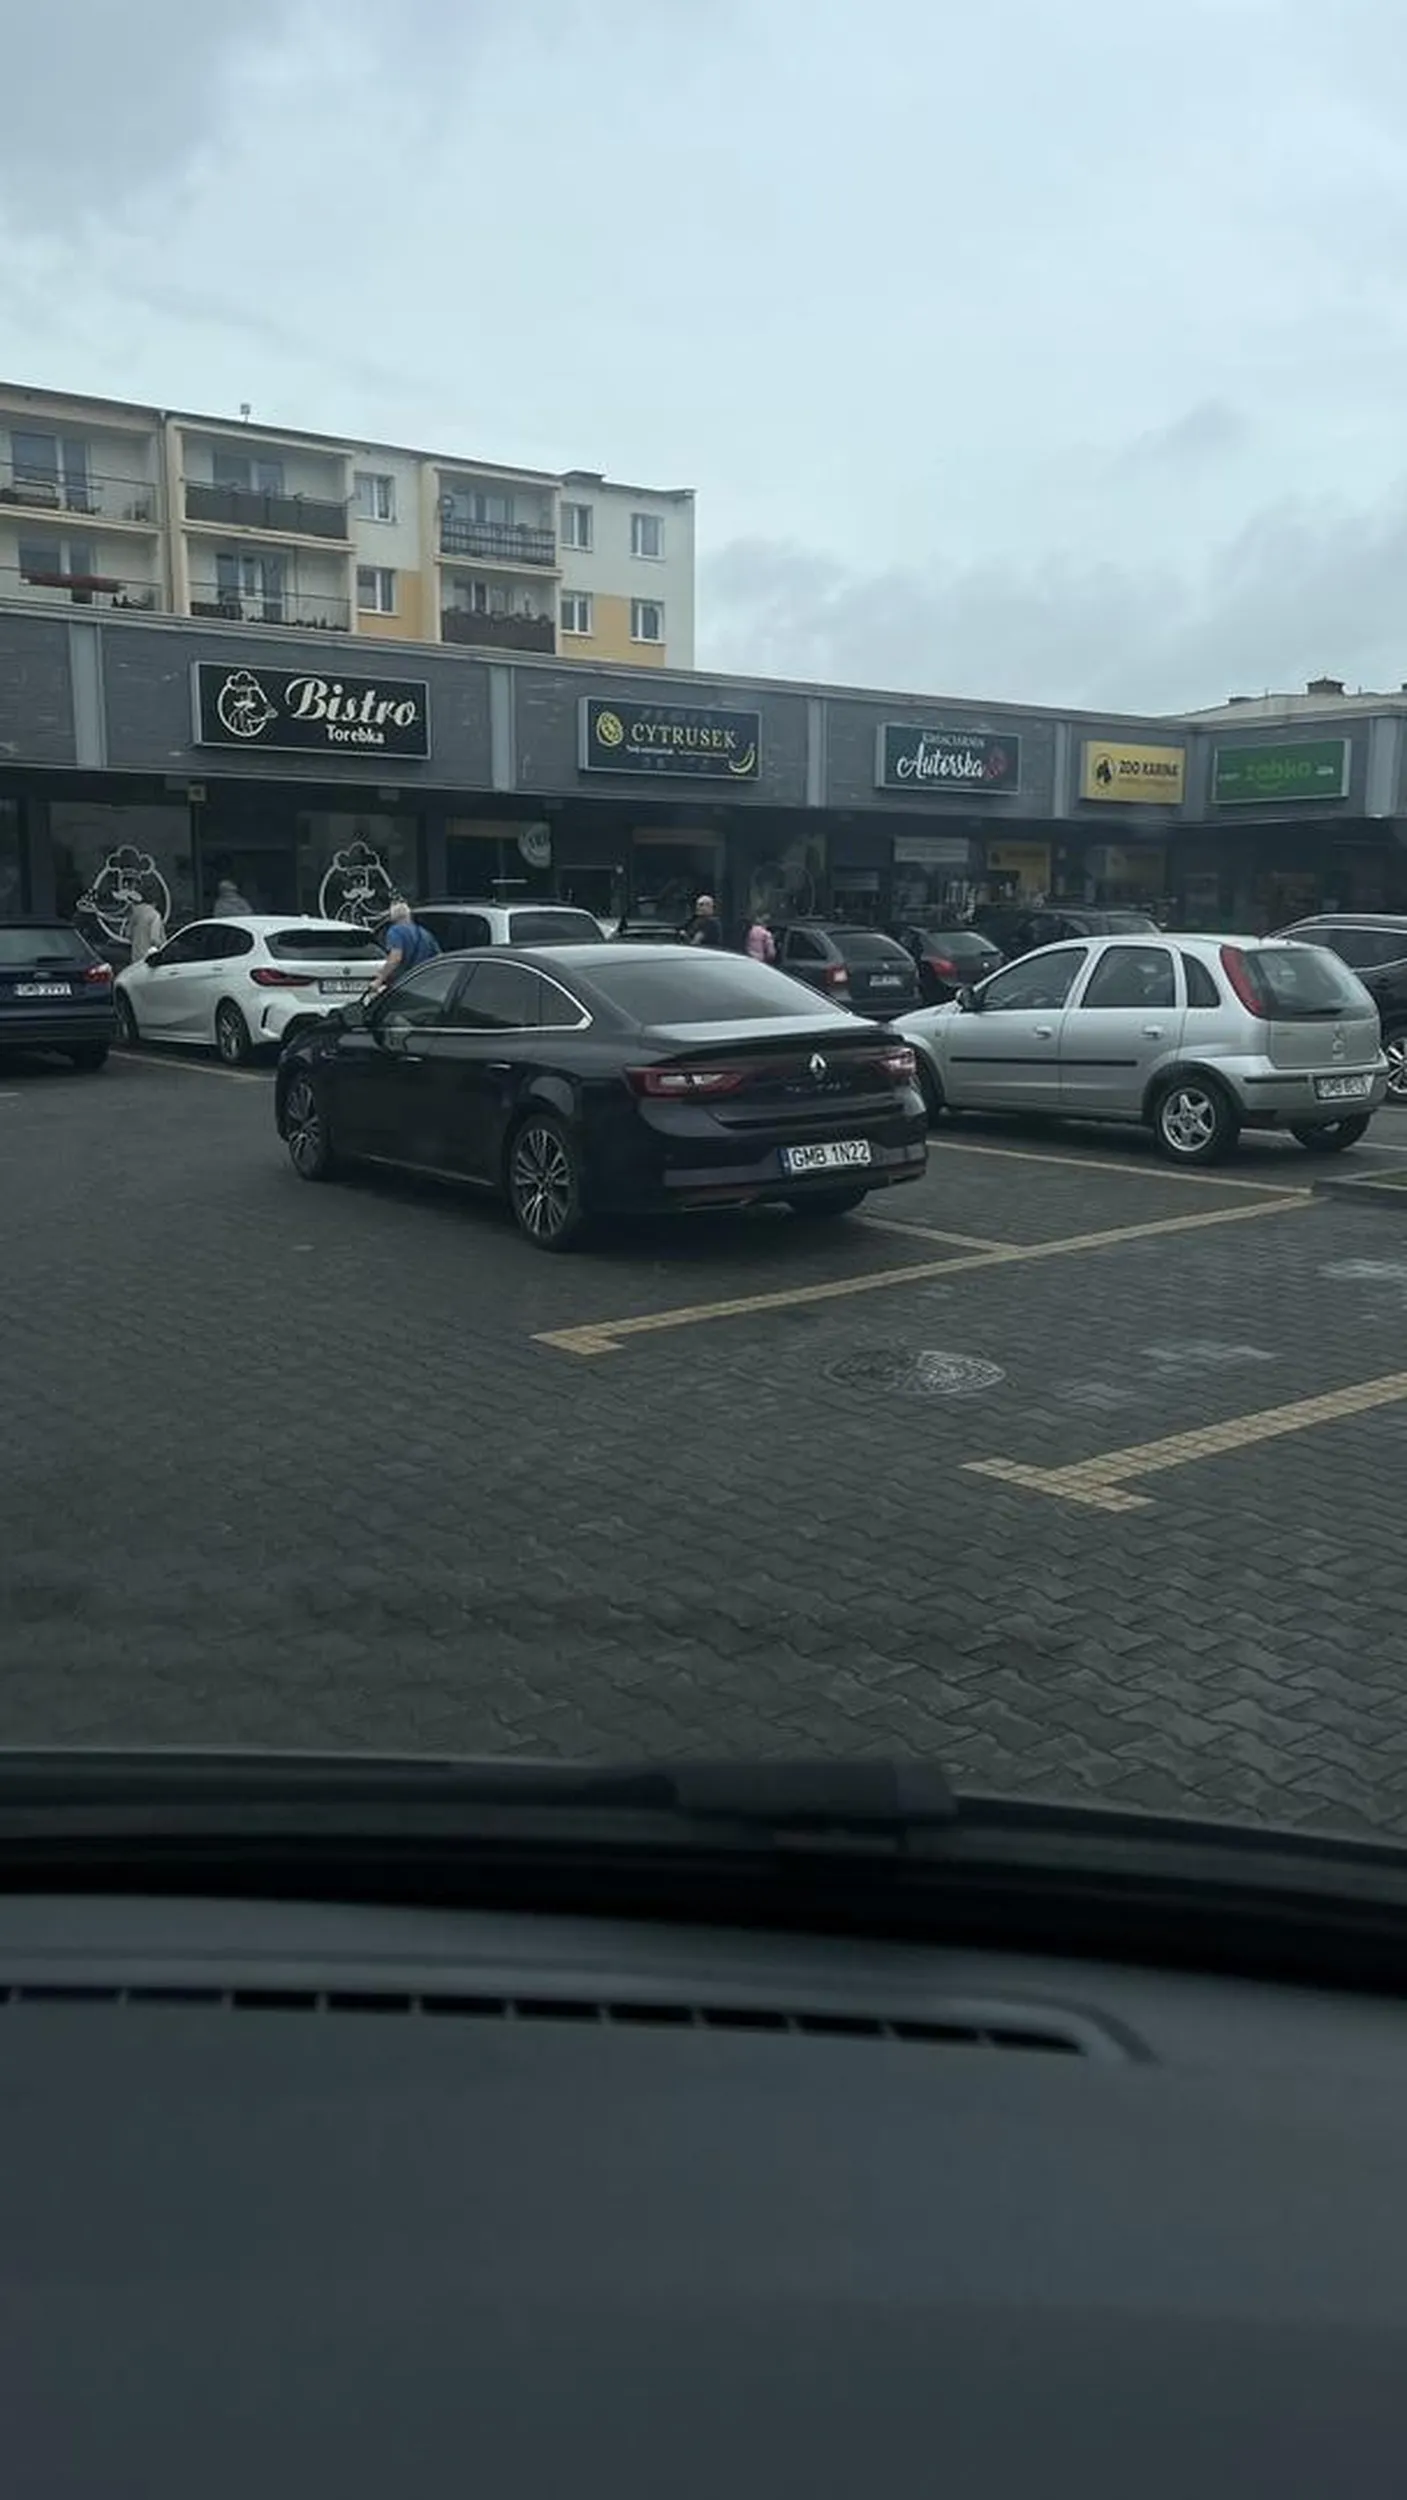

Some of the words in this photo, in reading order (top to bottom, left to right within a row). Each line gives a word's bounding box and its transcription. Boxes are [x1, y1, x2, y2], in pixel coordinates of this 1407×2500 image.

[285, 677, 419, 727] Bistro
[325, 724, 385, 744] Torebka
[631, 723, 737, 748] CYTRUSEK
[897, 741, 984, 779] Autorska
[1120, 759, 1140, 775] ZOO
[791, 1147, 827, 1168] GMB
[831, 1142, 868, 1163] 1N22
